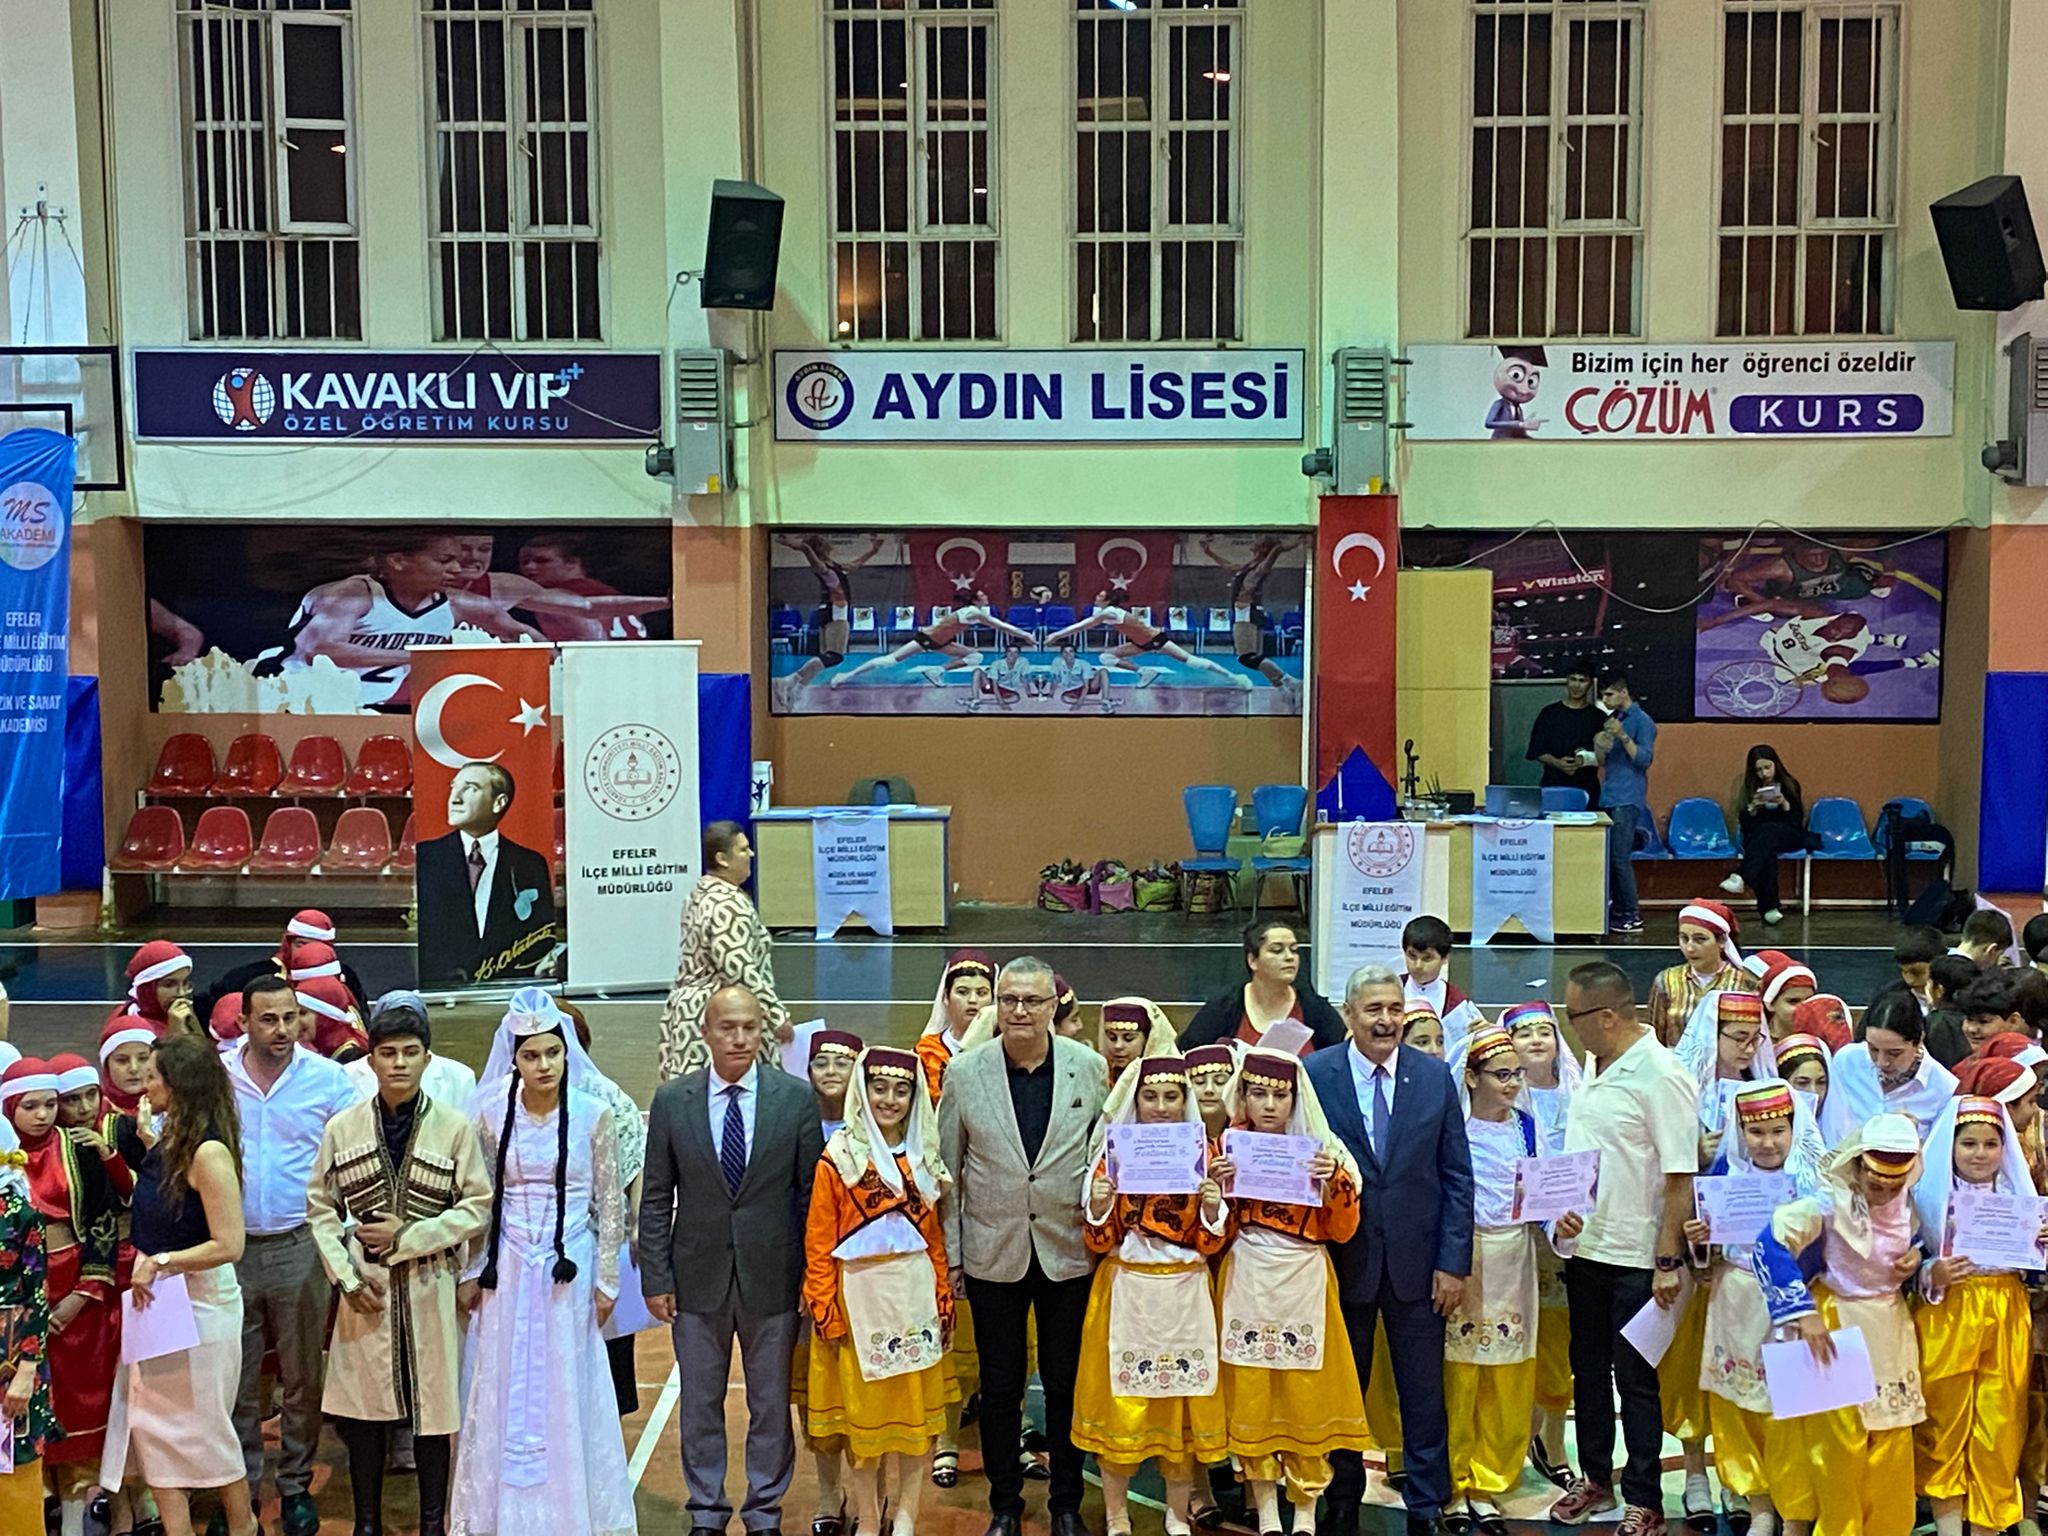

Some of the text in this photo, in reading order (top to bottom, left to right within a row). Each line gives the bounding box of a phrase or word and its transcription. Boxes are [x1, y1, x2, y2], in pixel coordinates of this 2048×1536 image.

[1571, 351, 1916, 379] Bizim için her öğrenci özeldir
[282, 372, 476, 410] KAVAKLI
[872, 362, 1288, 420] AYDIN LİSESİ
[1564, 379, 1715, 435] ÇÖZÜM
[1759, 399, 1899, 428] KURS
[283, 412, 569, 431] ÖZEL ÖĞRETİM KURSU
[3, 498, 50, 524] MS
[1536, 573, 1605, 589] Winston
[6, 611, 41, 628] EFELER
[3, 632, 66, 650] MİLLİ EĞİTİM
[15, 695, 27, 710] VE
[28, 695, 62, 710] SANAT
[0, 716, 48, 733] KADEMİSİ
[1499, 838, 1528, 846] EFELER
[612, 848, 657, 860] EFELER
[582, 863, 689, 880] İLÇE MİLLİ EĞİTİM
[597, 880, 673, 895] MÜDÜRLÜĞÜ
[1362, 887, 1394, 895] EFELER
[1342, 902, 1412, 913] İLÇE MİLLİ EĞİTİM
[1350, 919, 1402, 930] MÜDÜRLÜĞÜ
